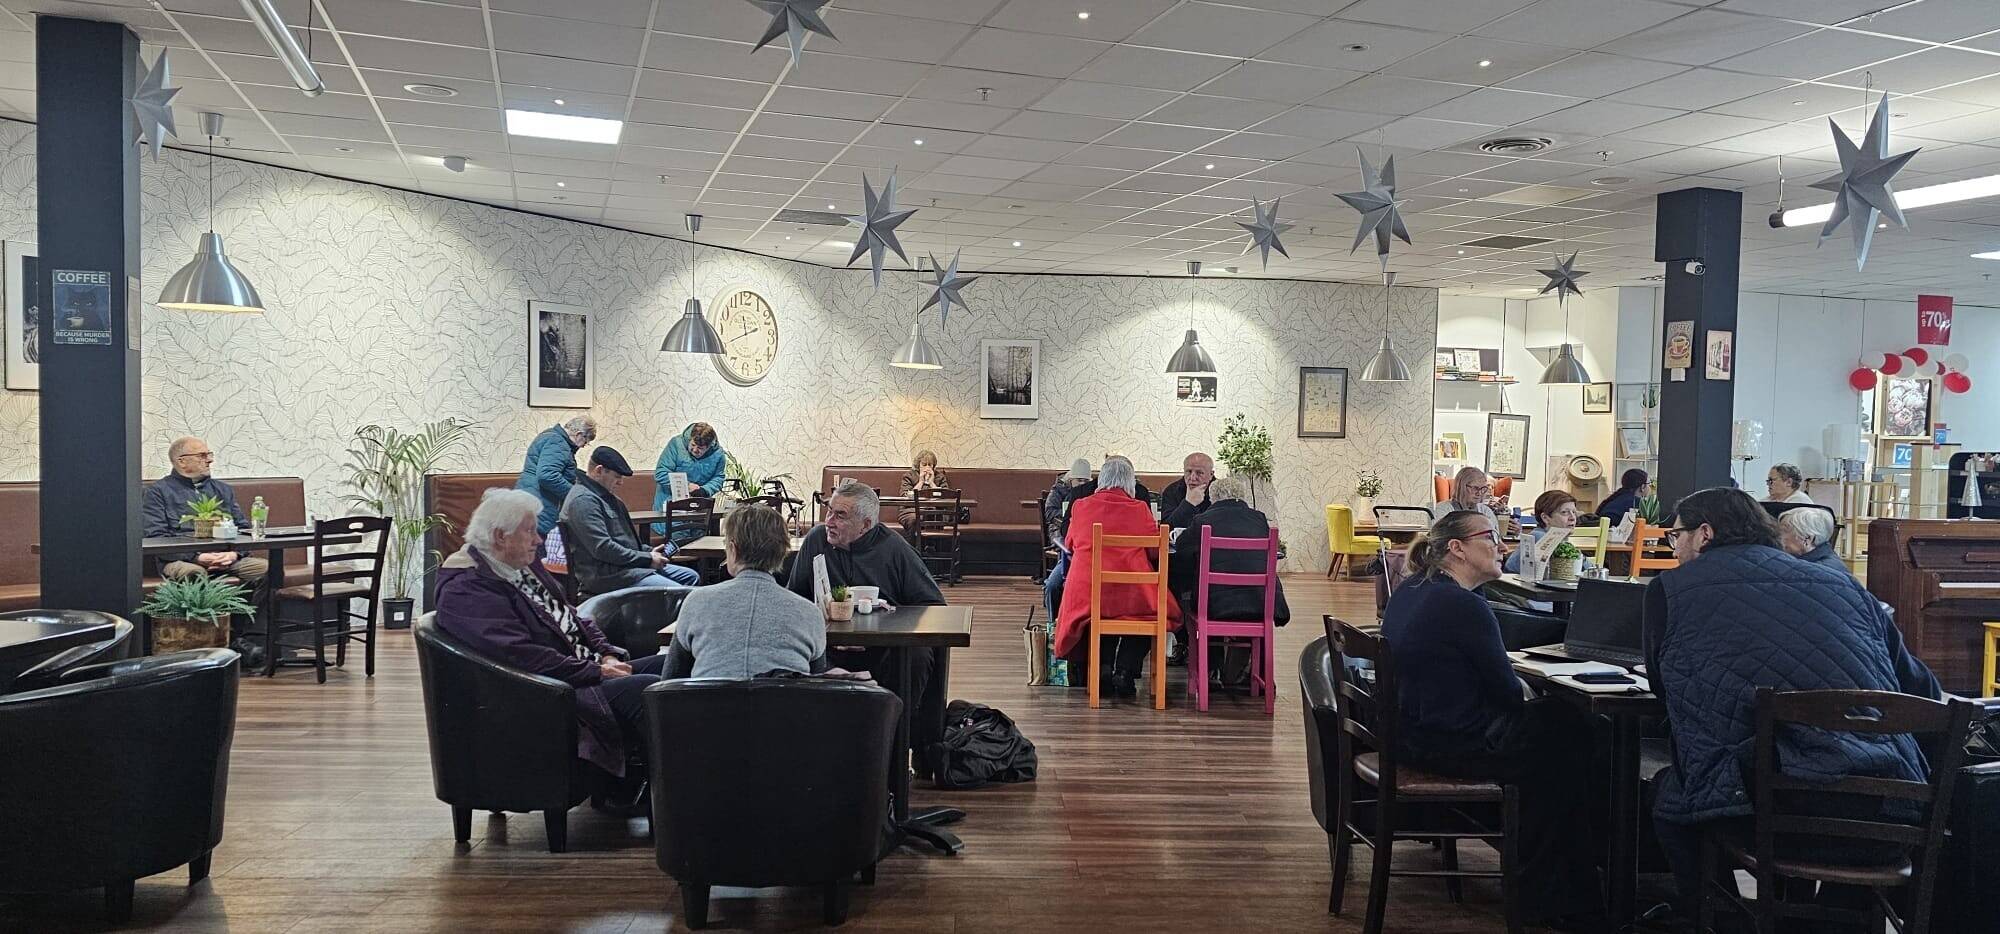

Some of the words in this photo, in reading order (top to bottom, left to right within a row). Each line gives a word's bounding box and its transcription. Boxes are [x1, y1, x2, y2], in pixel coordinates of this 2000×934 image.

[57, 273, 106, 284] COFFEE
[739, 292, 752, 306] 12
[763, 310, 771, 326] 2
[767, 329, 775, 345] 3
[763, 347, 772, 361] 4
[730, 356, 738, 369] 7
[741, 362, 750, 376] 6
[755, 359, 763, 374] 5
